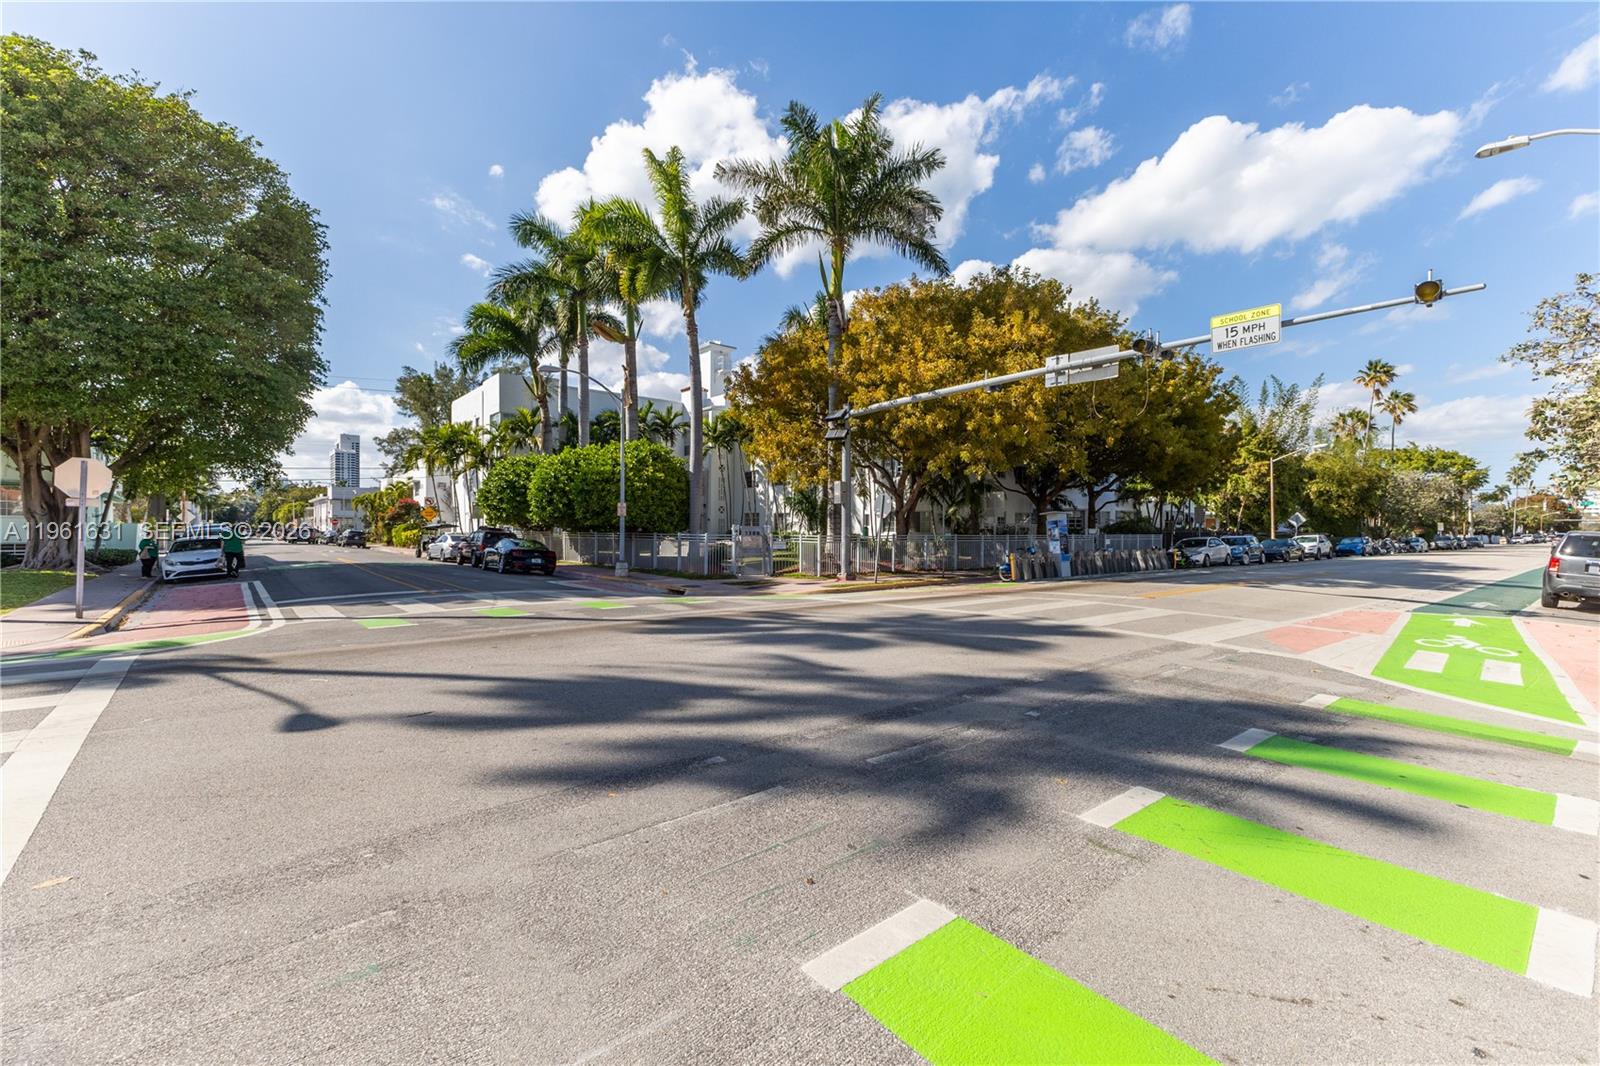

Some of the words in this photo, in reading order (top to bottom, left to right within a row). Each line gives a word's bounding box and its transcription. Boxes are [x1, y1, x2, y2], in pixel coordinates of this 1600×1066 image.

[1220, 313, 1247, 325] SCHOOL
[1251, 309, 1271, 319] ZONE
[1225, 326, 1239, 339] 15
[1242, 322, 1266, 334] MPH
[1217, 340, 1237, 350] WHEN
[1240, 331, 1277, 346] FLASHING
